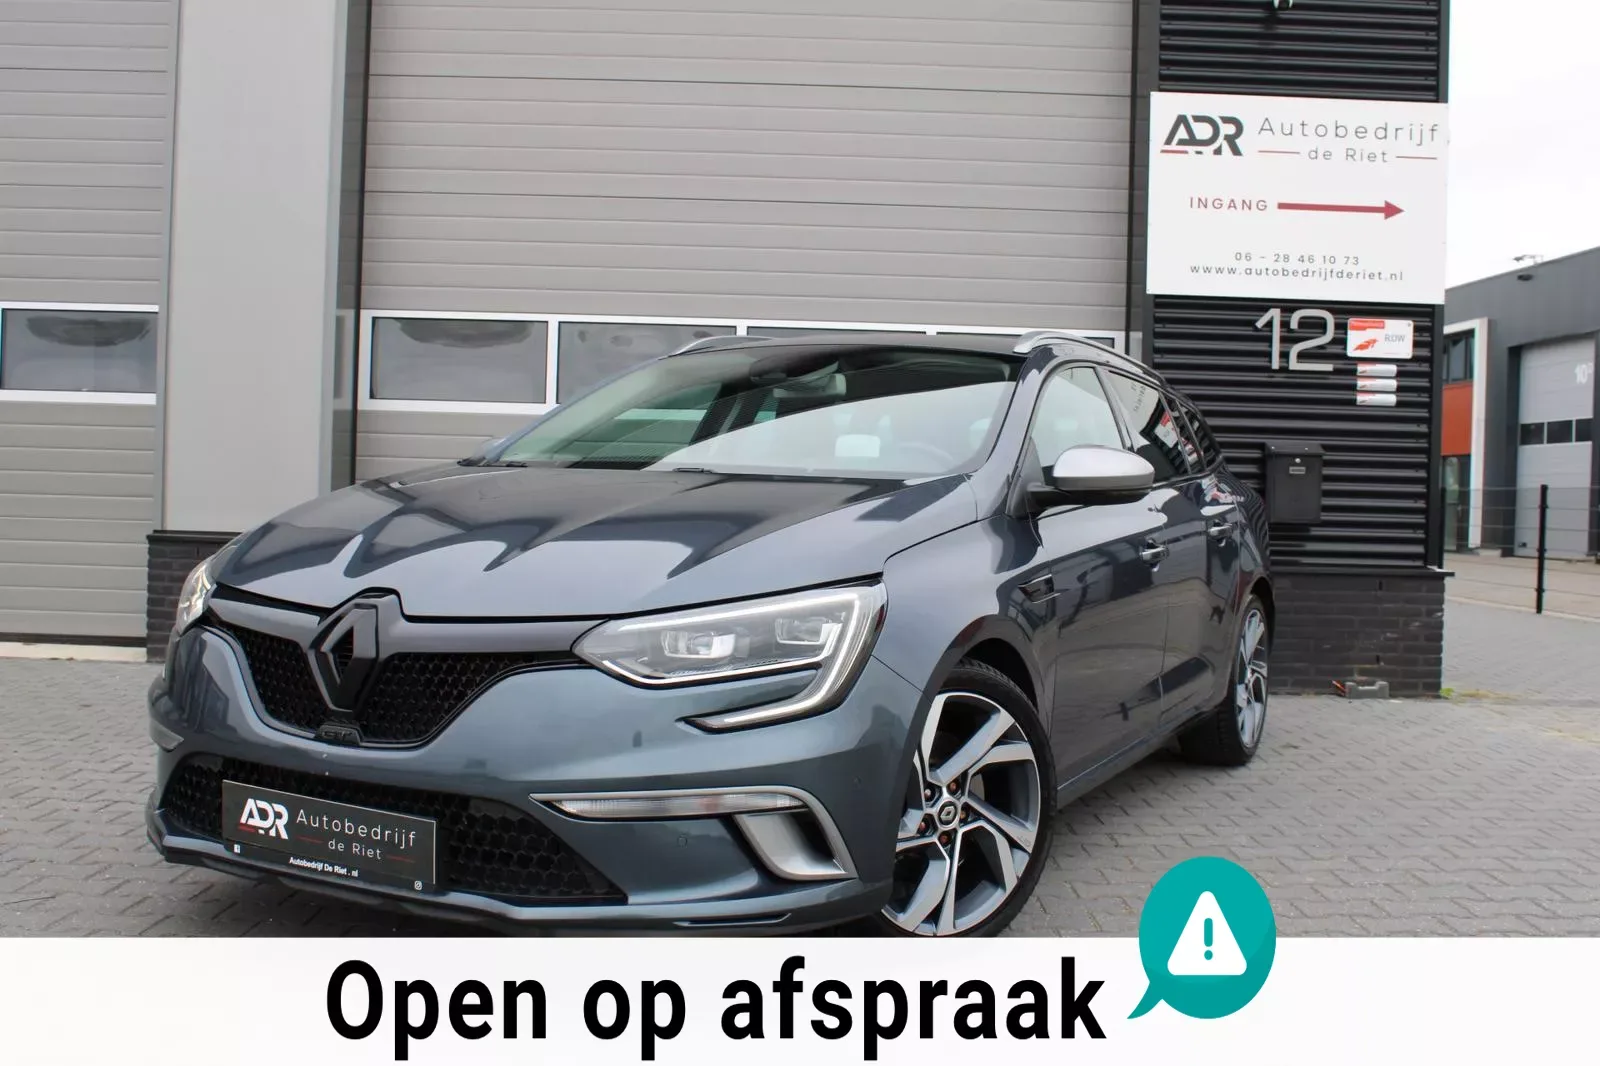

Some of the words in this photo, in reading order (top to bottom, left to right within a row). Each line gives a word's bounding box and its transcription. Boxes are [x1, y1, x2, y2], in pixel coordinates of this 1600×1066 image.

[1162, 114, 1244, 156] ADR
[1258, 117, 1440, 146] Autobedrijf
[1308, 147, 1332, 161] de
[1346, 148, 1388, 163] Riet
[1189, 196, 1268, 211] INGANG
[1234, 252, 1252, 262] 06
[1273, 253, 1290, 263] 28
[1297, 254, 1315, 265] 46
[1322, 255, 1336, 265] 10
[1343, 256, 1360, 266] 73
[1254, 308, 1335, 372] 12
[239, 798, 289, 840] ADR
[296, 808, 416, 849] Autobedrijf
[328, 838, 345, 852] de
[352, 842, 382, 860] Riet
[289, 856, 324, 872] Autobedrijf
[324, 863, 333, 873] De
[334, 865, 347, 875] Riet
